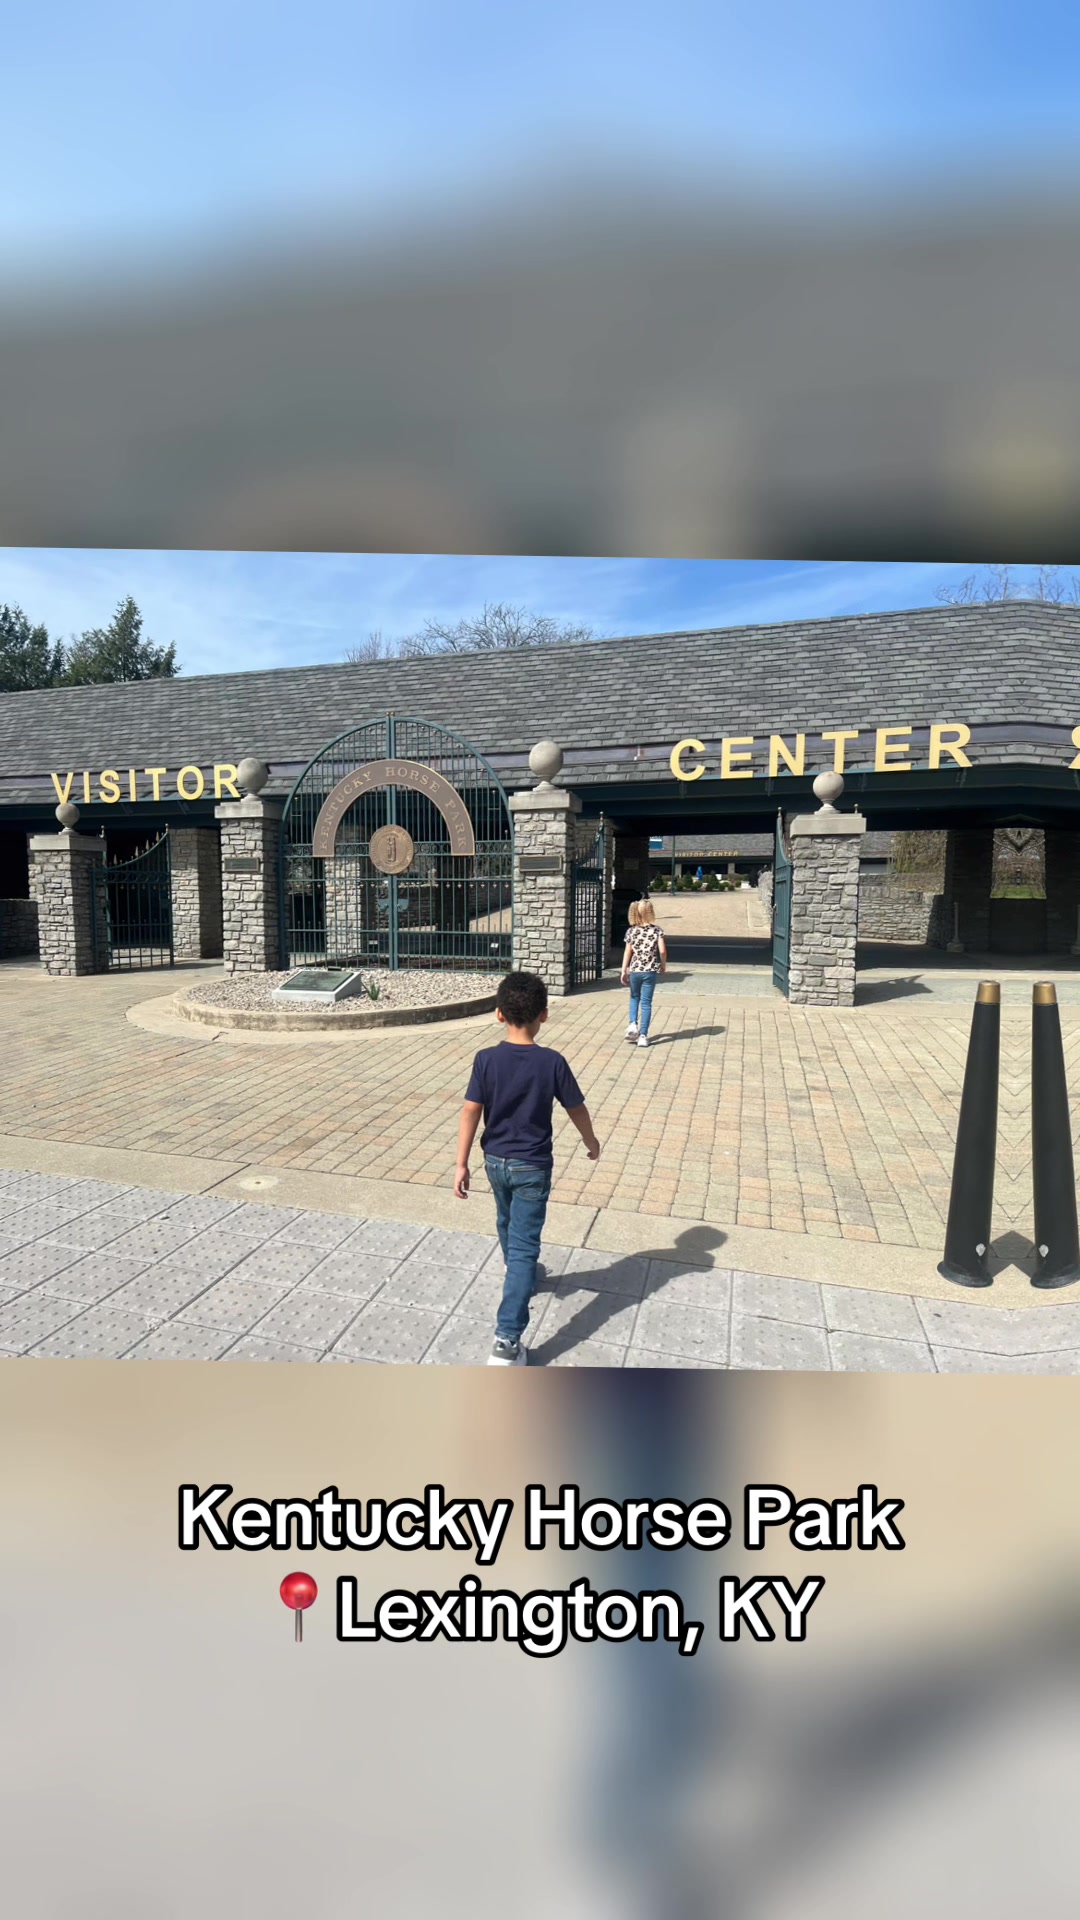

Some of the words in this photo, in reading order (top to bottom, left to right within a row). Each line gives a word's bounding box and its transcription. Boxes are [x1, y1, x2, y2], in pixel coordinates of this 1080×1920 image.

[51, 763, 242, 804] VISITOR
[669, 722, 974, 782] CENTER
[320, 770, 373, 850] KENTUCKY
[385, 766, 441, 794] HORSE
[444, 798, 468, 848] PARK
